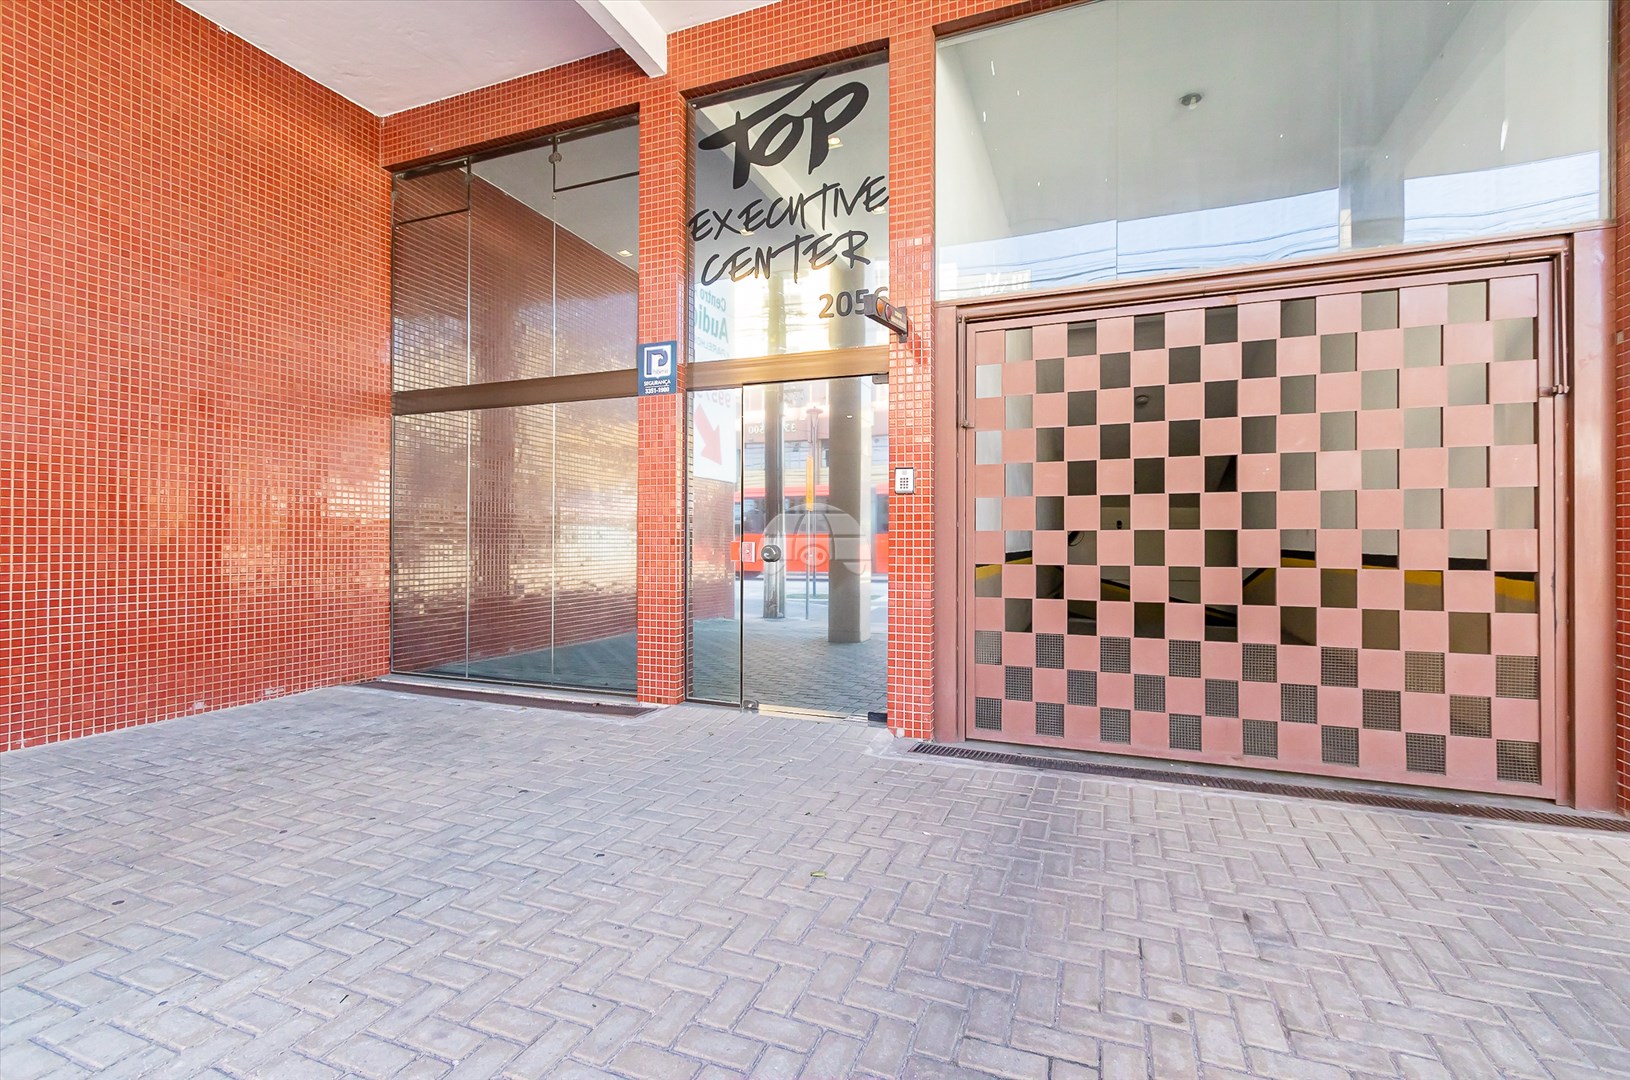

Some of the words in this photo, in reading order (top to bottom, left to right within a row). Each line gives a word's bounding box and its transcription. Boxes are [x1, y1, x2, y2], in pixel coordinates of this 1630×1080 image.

[698, 71, 870, 190] TOP
[689, 175, 889, 242] EXECUTIVE
[701, 229, 871, 287] CENTER
